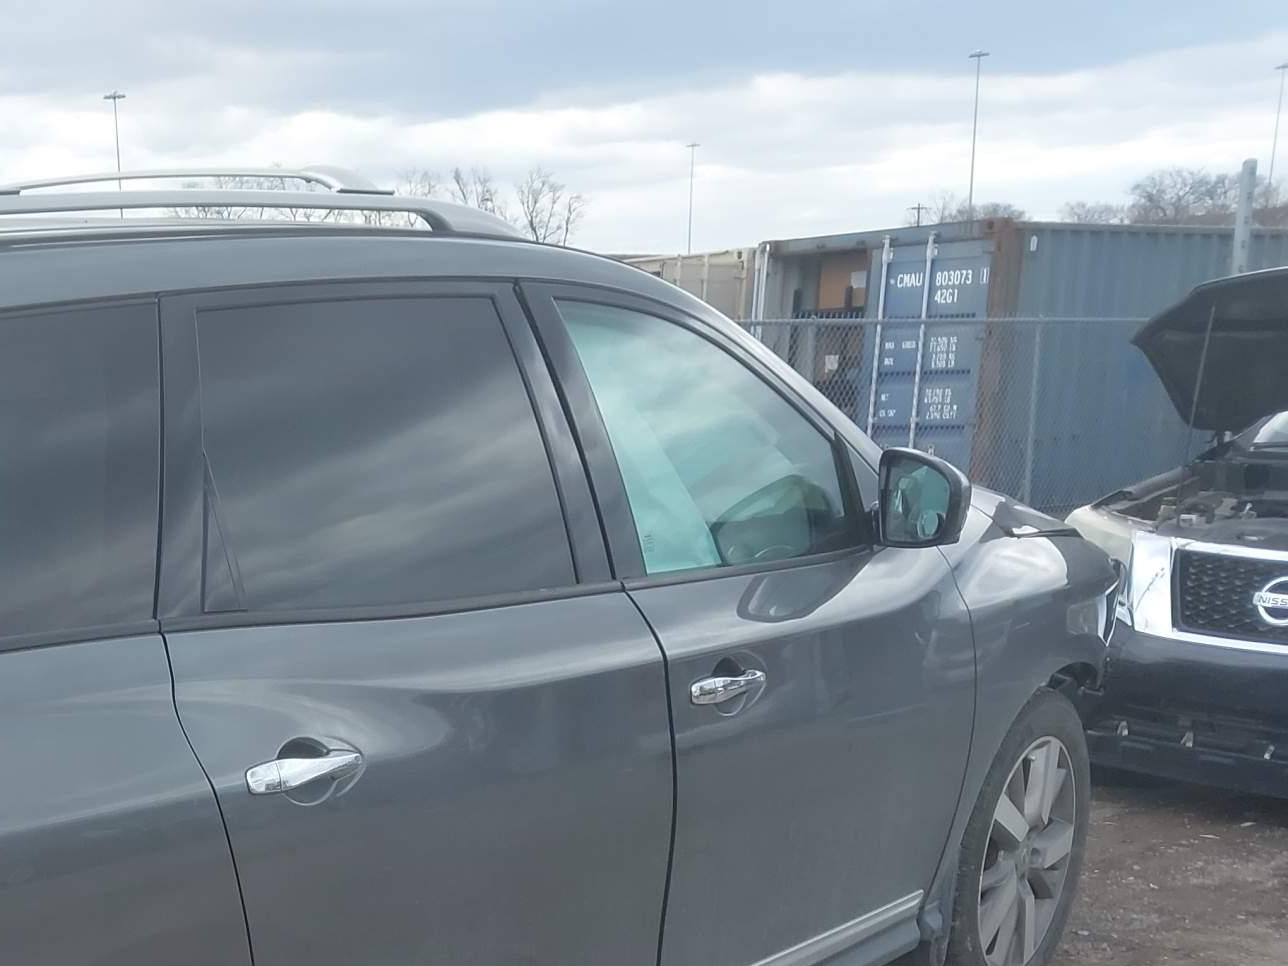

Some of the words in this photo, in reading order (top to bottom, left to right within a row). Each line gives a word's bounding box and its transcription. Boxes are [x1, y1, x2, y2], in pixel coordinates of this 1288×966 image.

[897, 272, 923, 288] CMAU
[936, 269, 972, 287] 803073
[934, 288, 958, 304] 42G1
